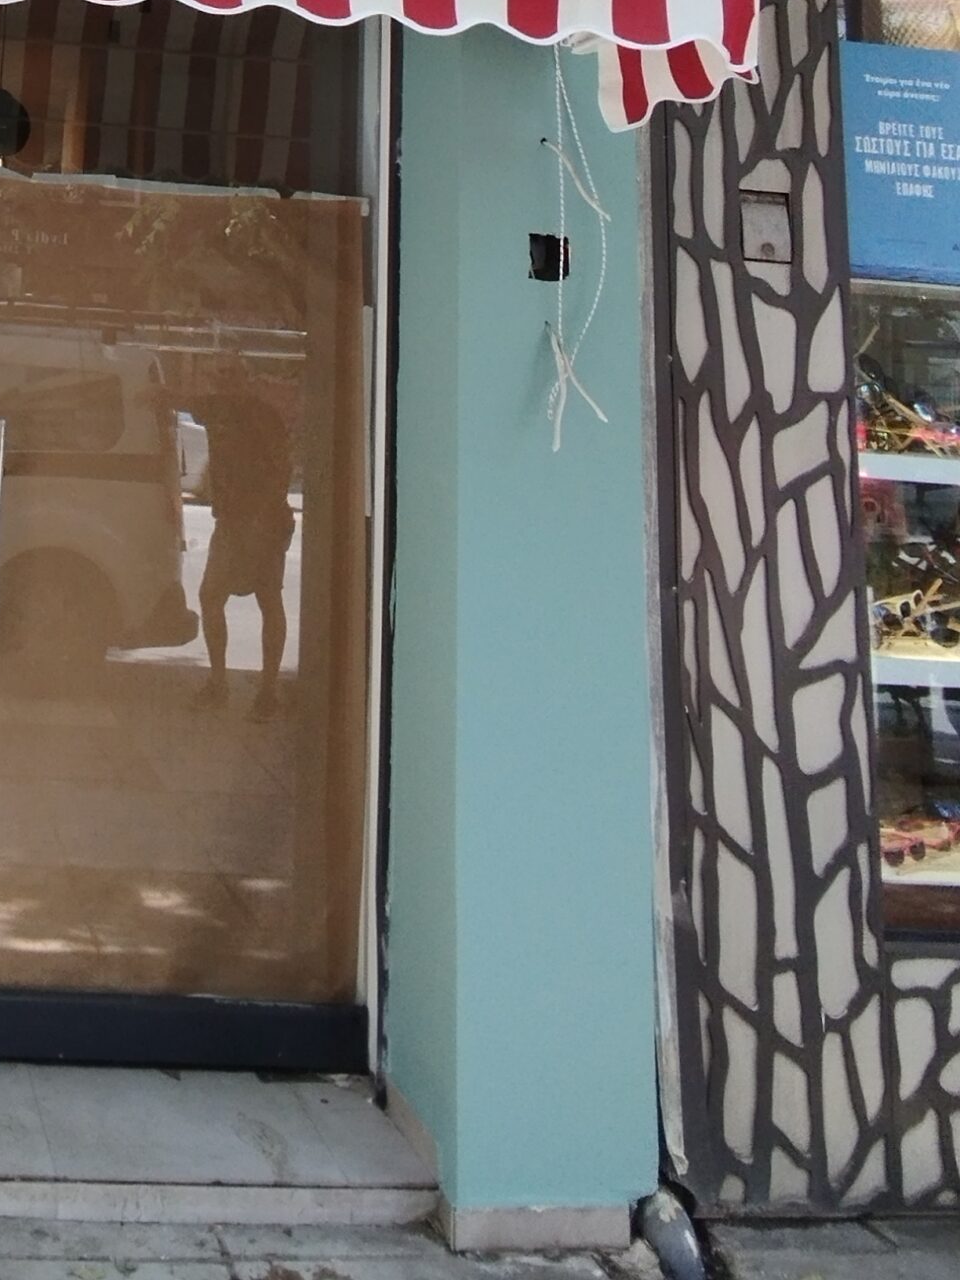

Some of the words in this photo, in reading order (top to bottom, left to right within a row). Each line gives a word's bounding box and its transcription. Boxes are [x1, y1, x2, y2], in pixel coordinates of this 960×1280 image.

[878, 121, 915, 137] ΒΡΕΙΤΕ
[919, 124, 944, 140] ΤΟΥΣ
[855, 135, 911, 157] ΣΩΣΤΟΥΣ
[916, 140, 935, 158] ΓΙΑ
[865, 159, 921, 178] ΜΗΝΙΑΙΟΥΣ
[895, 181, 935, 198] ΕΠΑΦΗΣ
